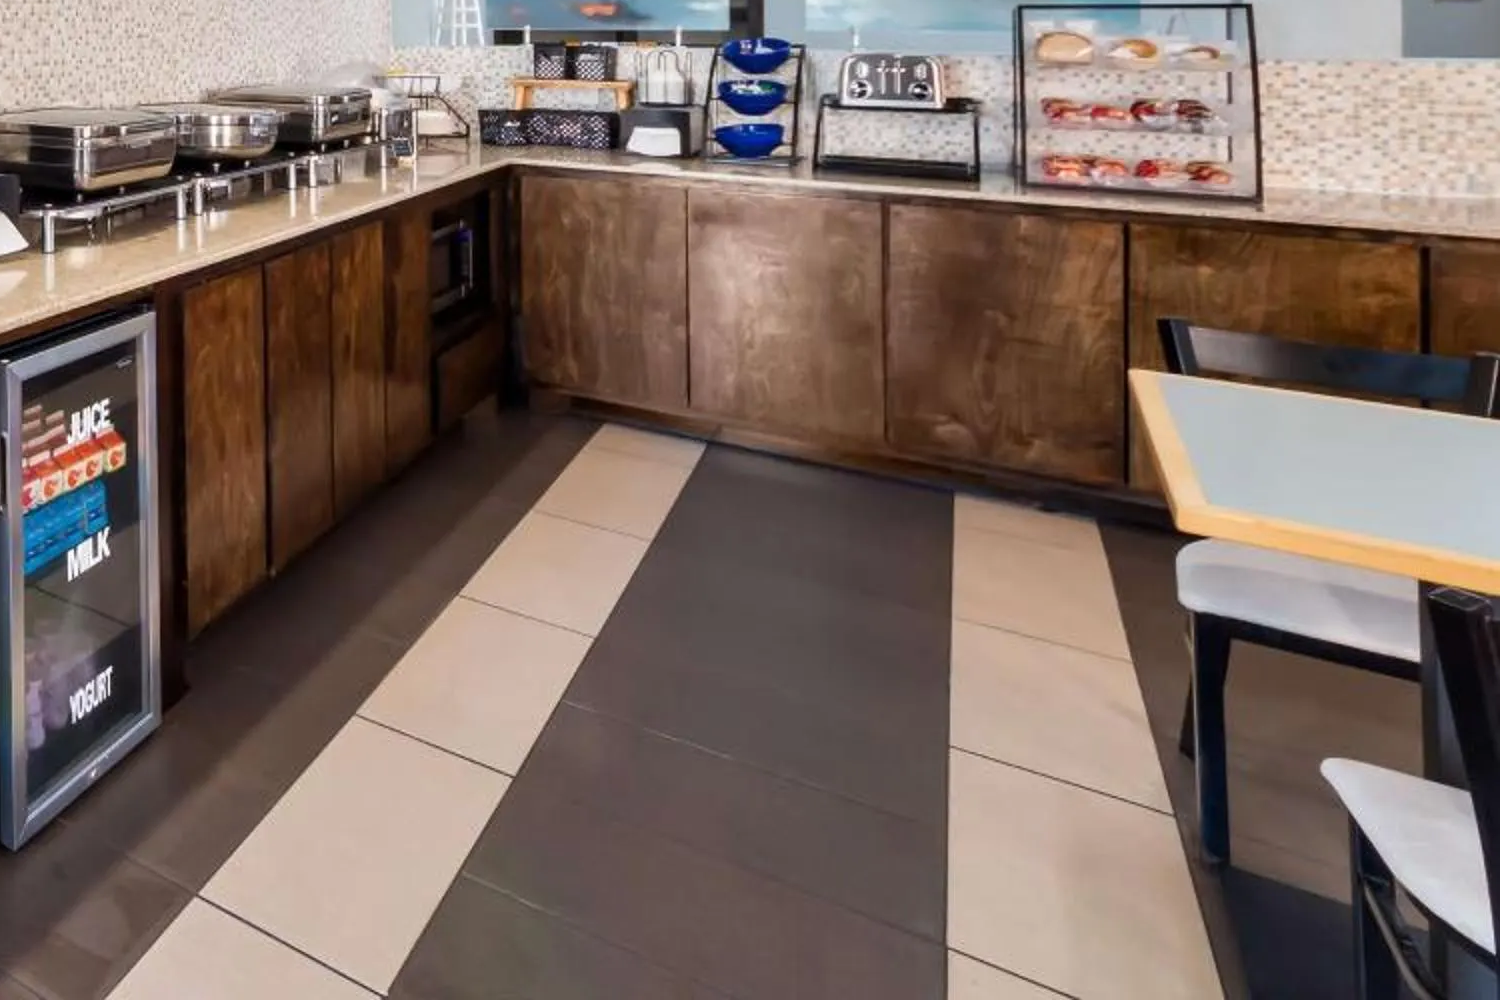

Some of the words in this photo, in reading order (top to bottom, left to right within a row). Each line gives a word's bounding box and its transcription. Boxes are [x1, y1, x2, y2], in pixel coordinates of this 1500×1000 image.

[67, 397, 113, 444] JUICE
[67, 526, 111, 582] MILK
[69, 665, 114, 725] YOGURT
